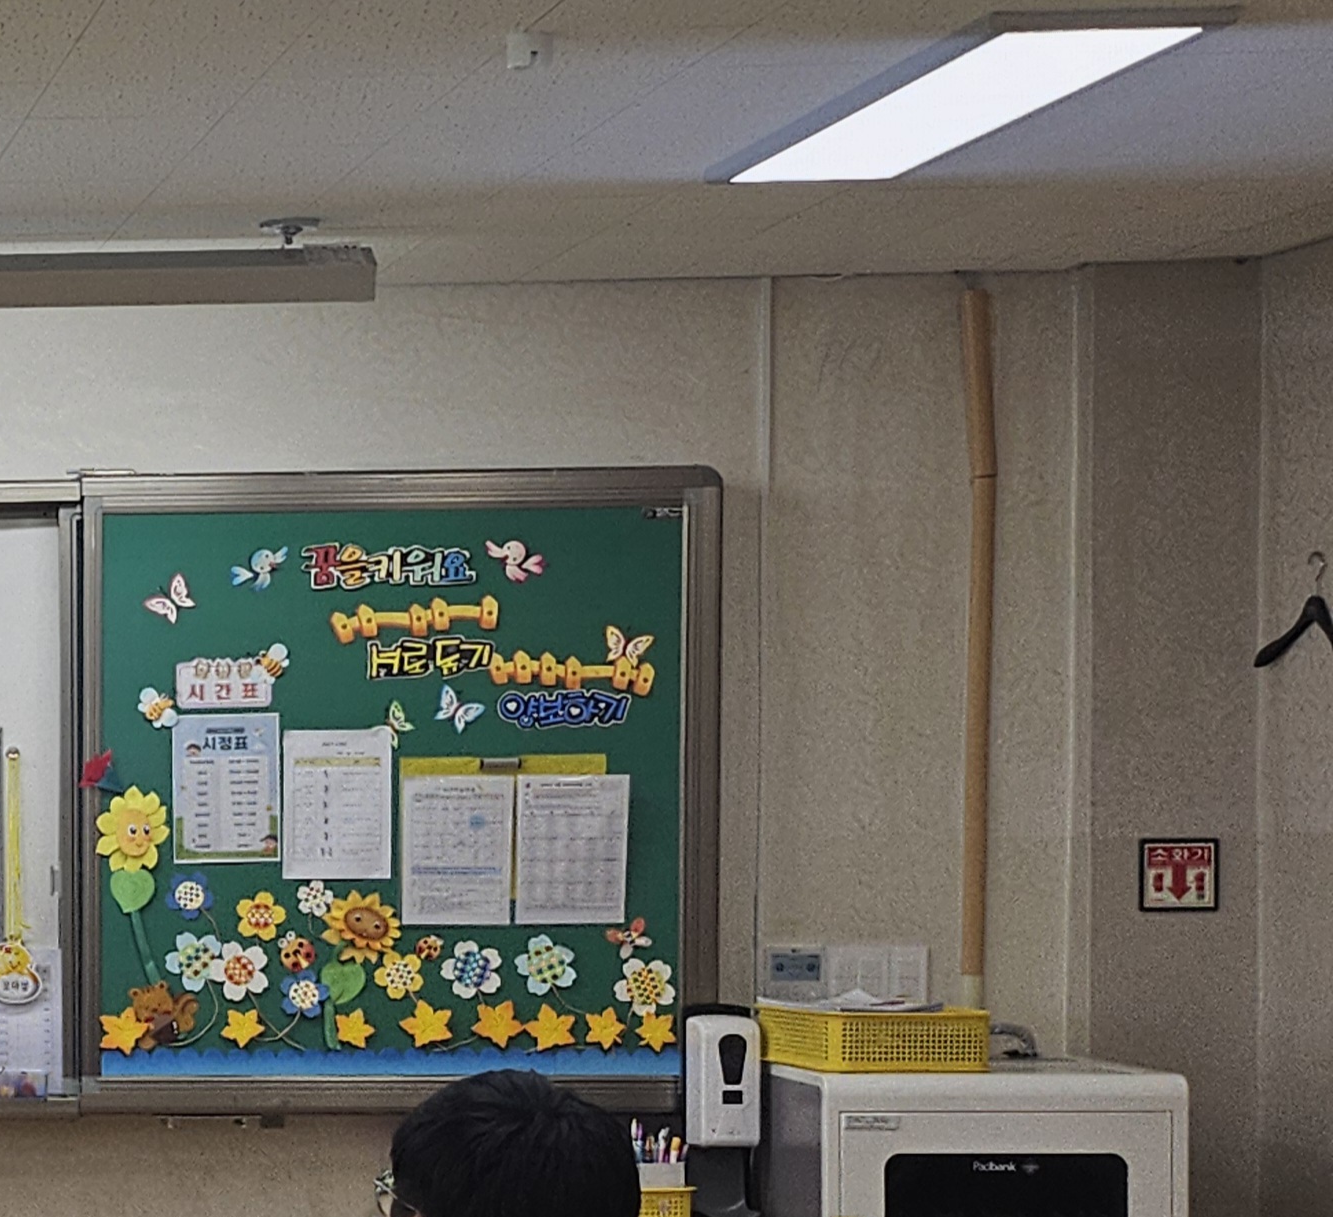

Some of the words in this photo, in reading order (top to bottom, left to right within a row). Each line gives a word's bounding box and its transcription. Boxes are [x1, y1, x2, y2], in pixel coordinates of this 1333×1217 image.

[303, 542, 475, 589] 꿈을키워요
[187, 682, 259, 701] 시간표
[499, 690, 630, 728] 양보하기
[203, 735, 249, 751] 시정표
[1150, 848, 1209, 861] 소화기
